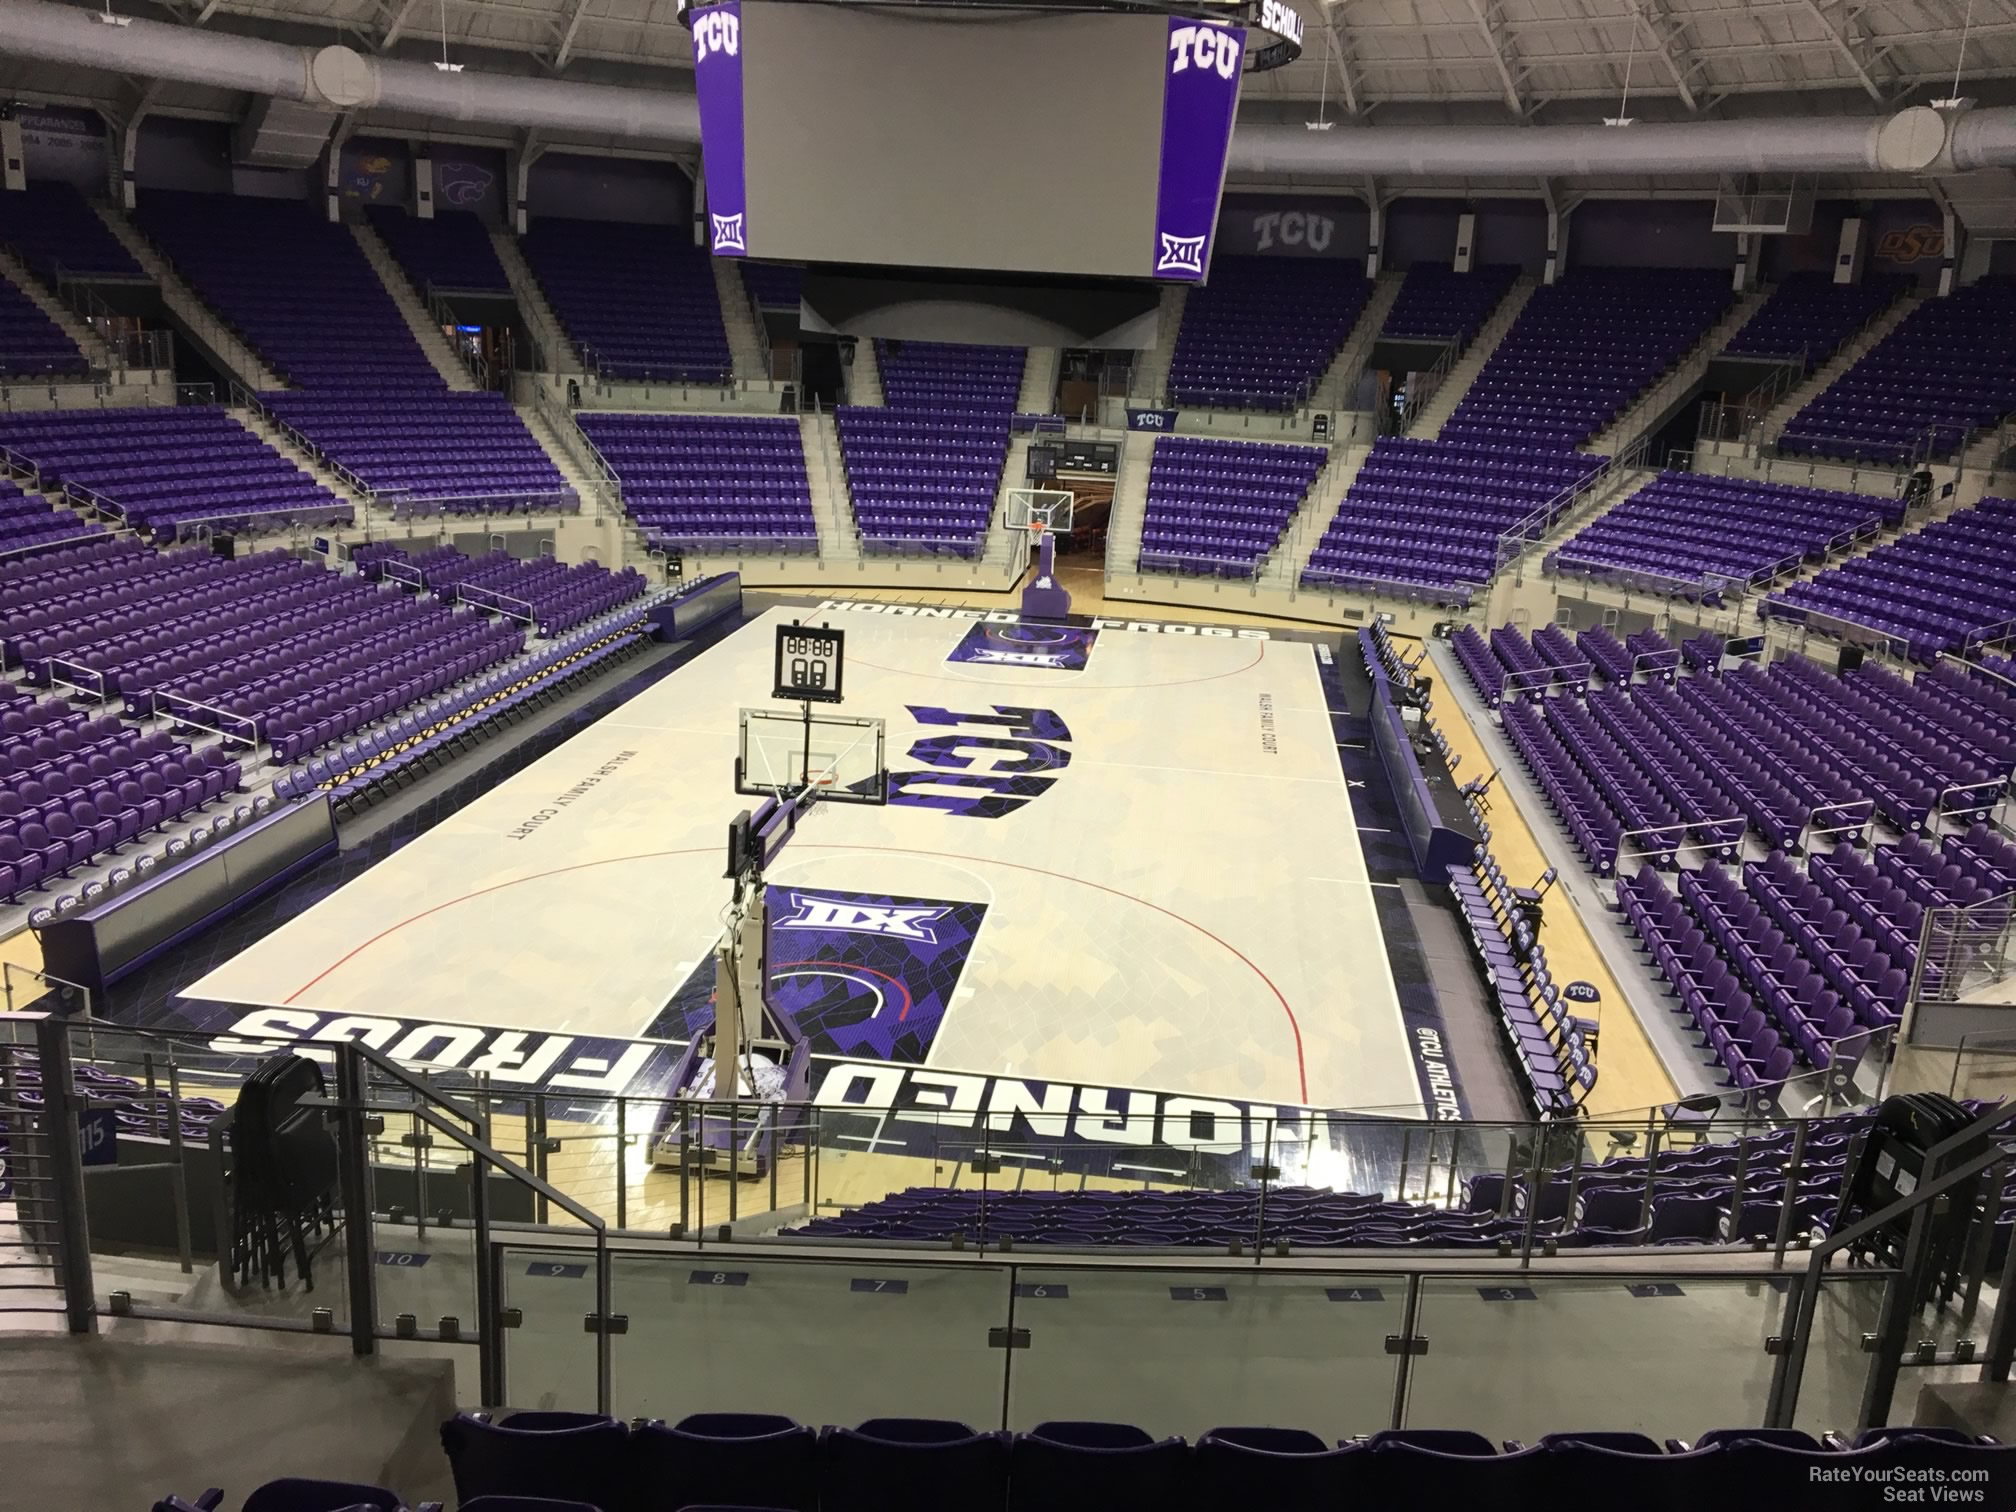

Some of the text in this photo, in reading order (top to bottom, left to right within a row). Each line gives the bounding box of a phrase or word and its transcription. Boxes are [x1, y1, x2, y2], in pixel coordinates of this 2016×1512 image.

[1262, 0, 1303, 46] SCHOLL
[693, 11, 738, 63] TCU
[1170, 27, 1239, 79] TCU
[1253, 212, 1335, 252] TCU
[1137, 413, 1163, 427] TCU
[816, 601, 1270, 640] HORNED FROGS
[1262, 733, 1277, 754] COURT
[846, 705, 1073, 819] TCU
[507, 751, 638, 840] WALSH FAMILY COURT
[1988, 788, 1998, 798] 12
[776, 894, 948, 942] XII
[1570, 985, 1594, 999] TCU
[813, 1064, 1338, 1172] HORNED
[386, 1253, 413, 1265] 10
[551, 1265, 565, 1276] 9
[712, 1273, 726, 1284] 8
[874, 1280, 887, 1291] 7
[1034, 1286, 1047, 1297] 6
[1193, 1288, 1206, 1300] 5
[1350, 1289, 1363, 1300] 4
[1500, 1289, 1515, 1300] 3
[1646, 1285, 1663, 1296] 2
